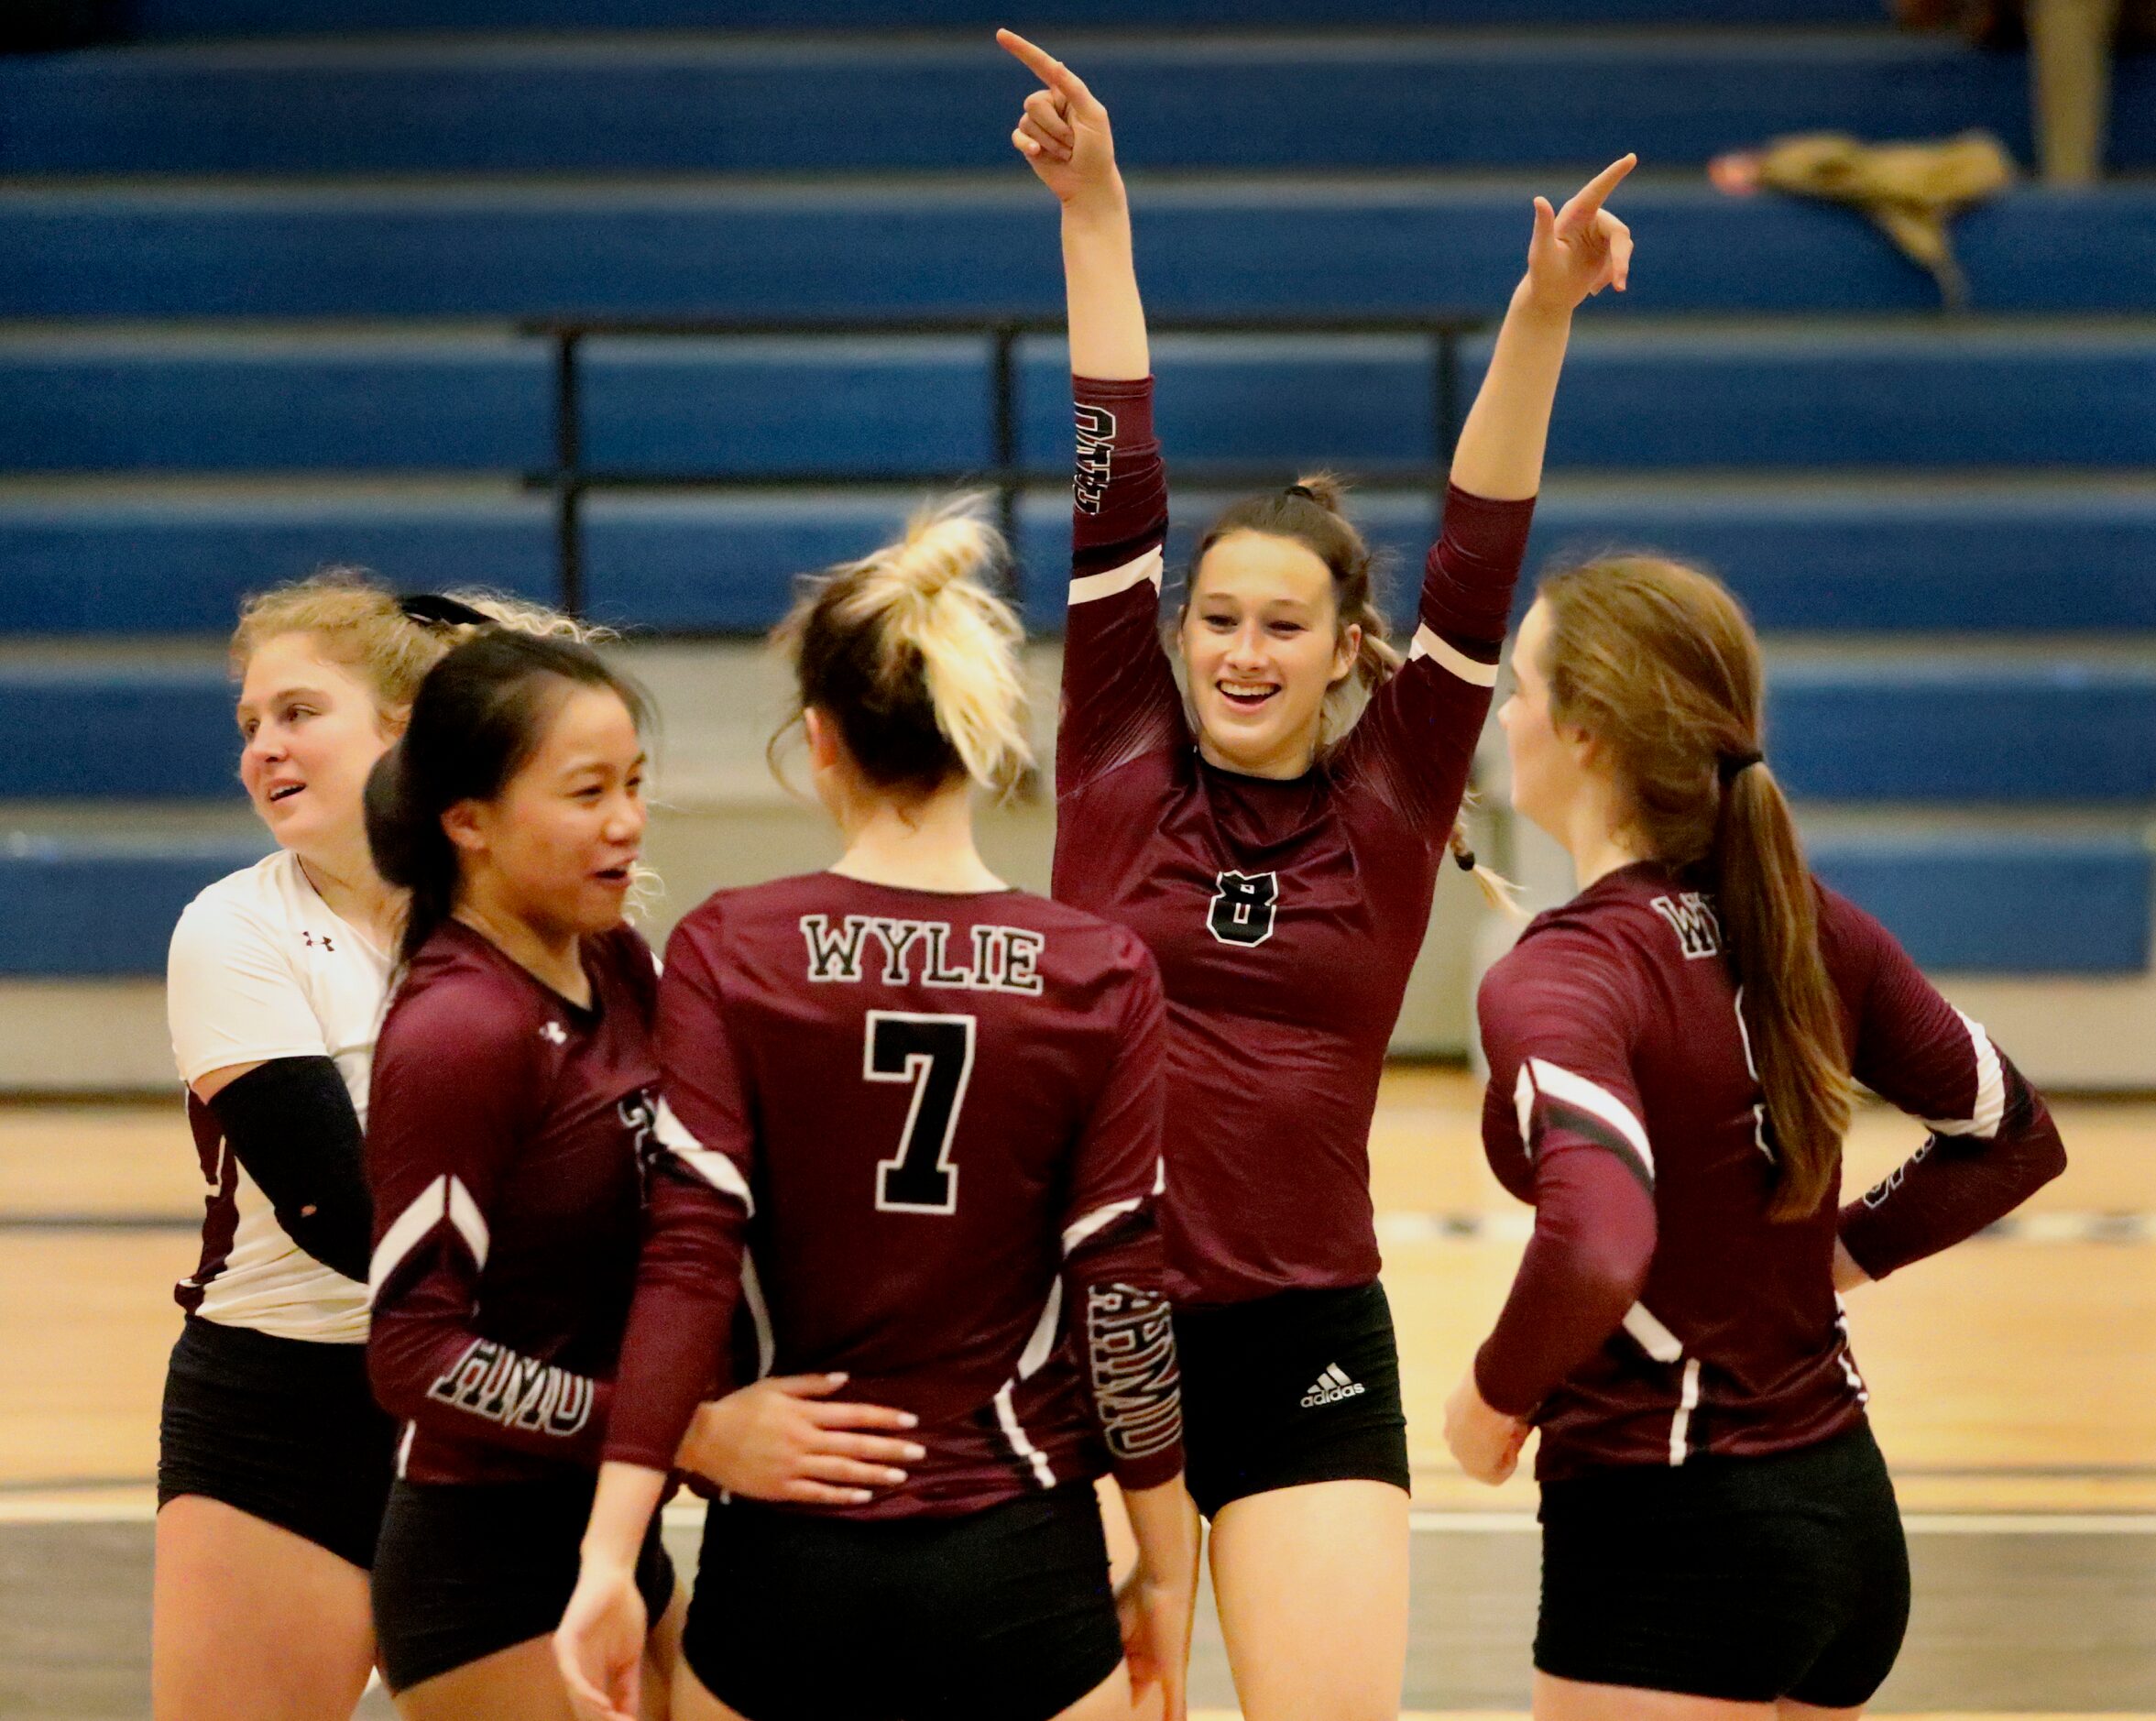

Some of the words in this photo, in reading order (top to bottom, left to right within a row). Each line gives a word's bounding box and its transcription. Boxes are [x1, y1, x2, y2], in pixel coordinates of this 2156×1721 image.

[1206, 870, 1278, 948] 8
[801, 915, 1045, 996] WYLIE
[863, 1010, 977, 1215] 7
[1300, 1382, 1365, 1408] adidas
